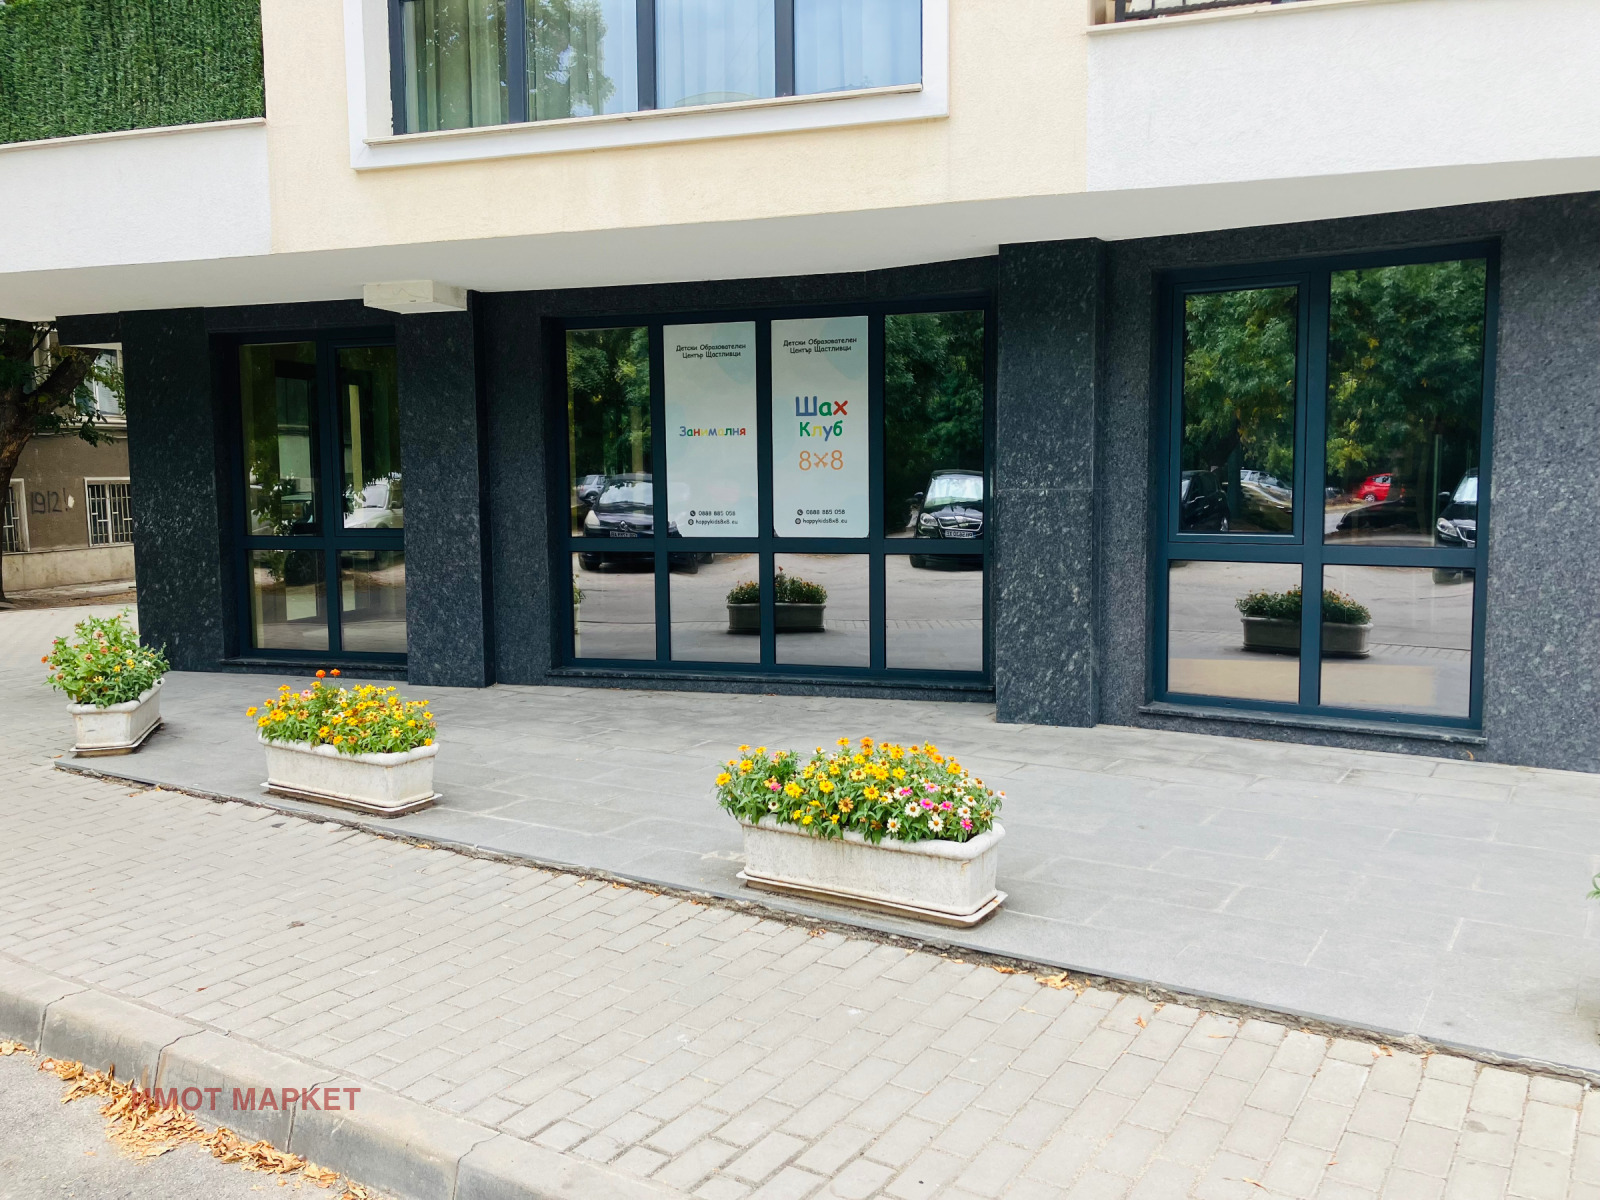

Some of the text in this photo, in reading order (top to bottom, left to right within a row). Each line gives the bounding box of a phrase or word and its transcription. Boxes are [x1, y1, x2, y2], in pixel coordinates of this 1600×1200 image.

[676, 344, 698, 352] Детски
[808, 338, 857, 346] Образователен
[795, 395, 848, 416] Шах
[679, 425, 746, 437] Занималня
[799, 420, 843, 441] Клуб
